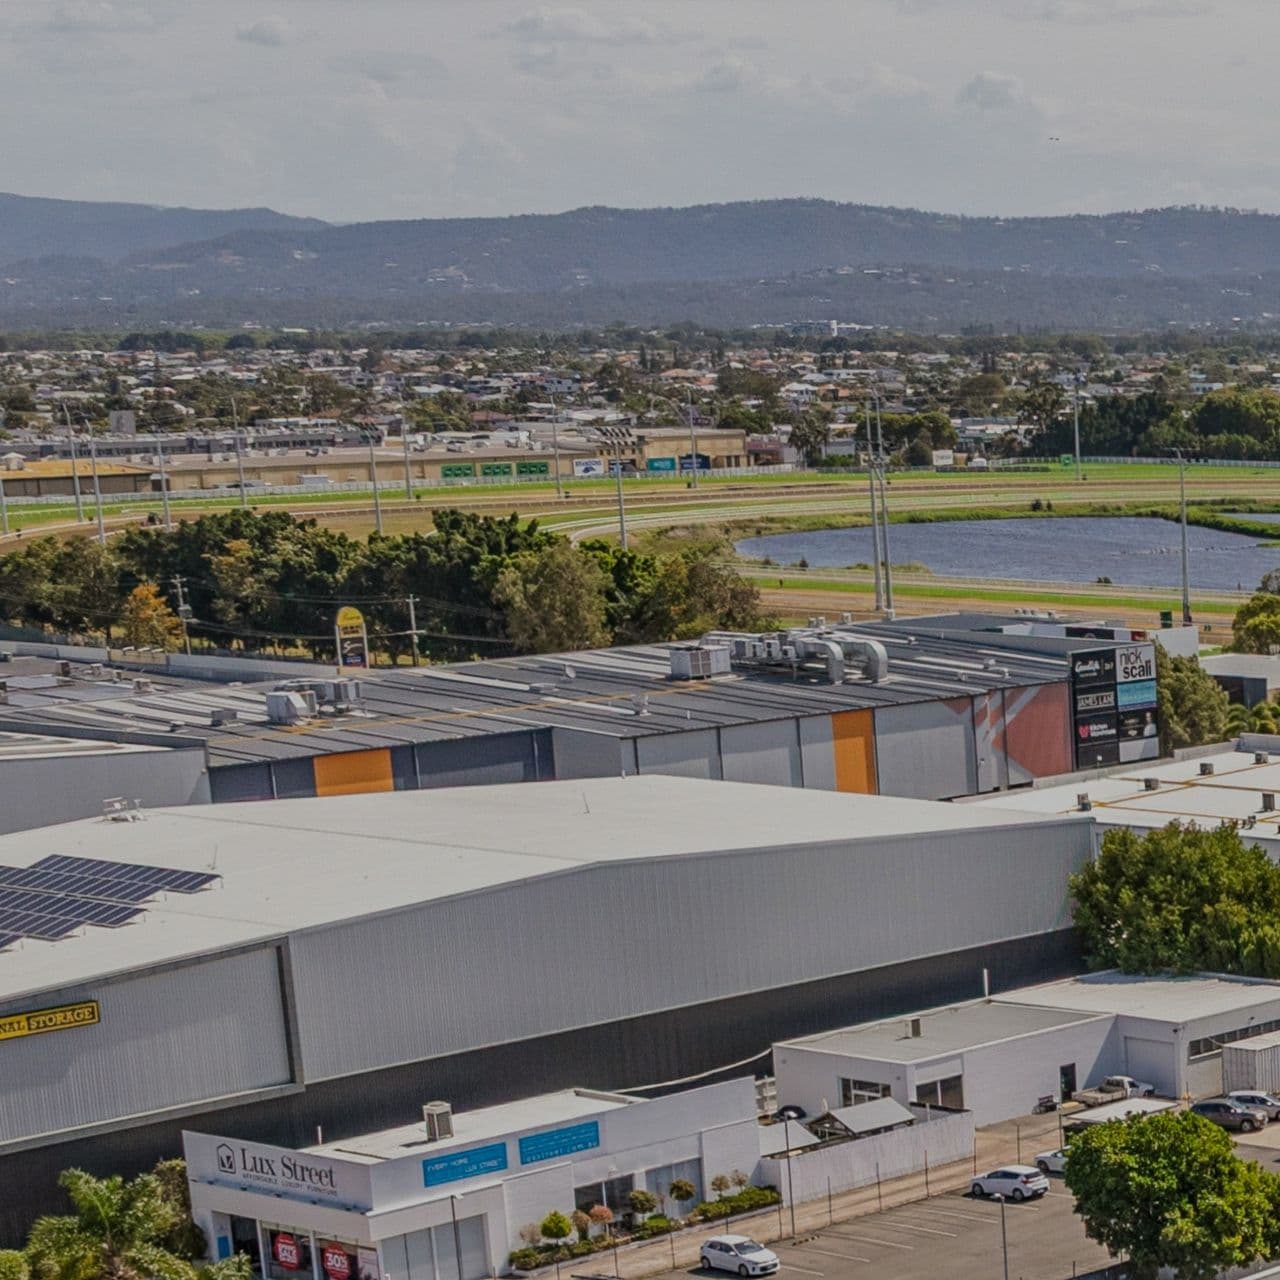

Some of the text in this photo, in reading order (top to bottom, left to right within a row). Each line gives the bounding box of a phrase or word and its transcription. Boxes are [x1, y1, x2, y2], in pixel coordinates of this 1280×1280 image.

[1120, 649, 1142, 666] nick
[1123, 660, 1152, 679] scali
[30, 1007, 93, 1030] STORAGE
[241, 1148, 337, 1189] Lux Street
